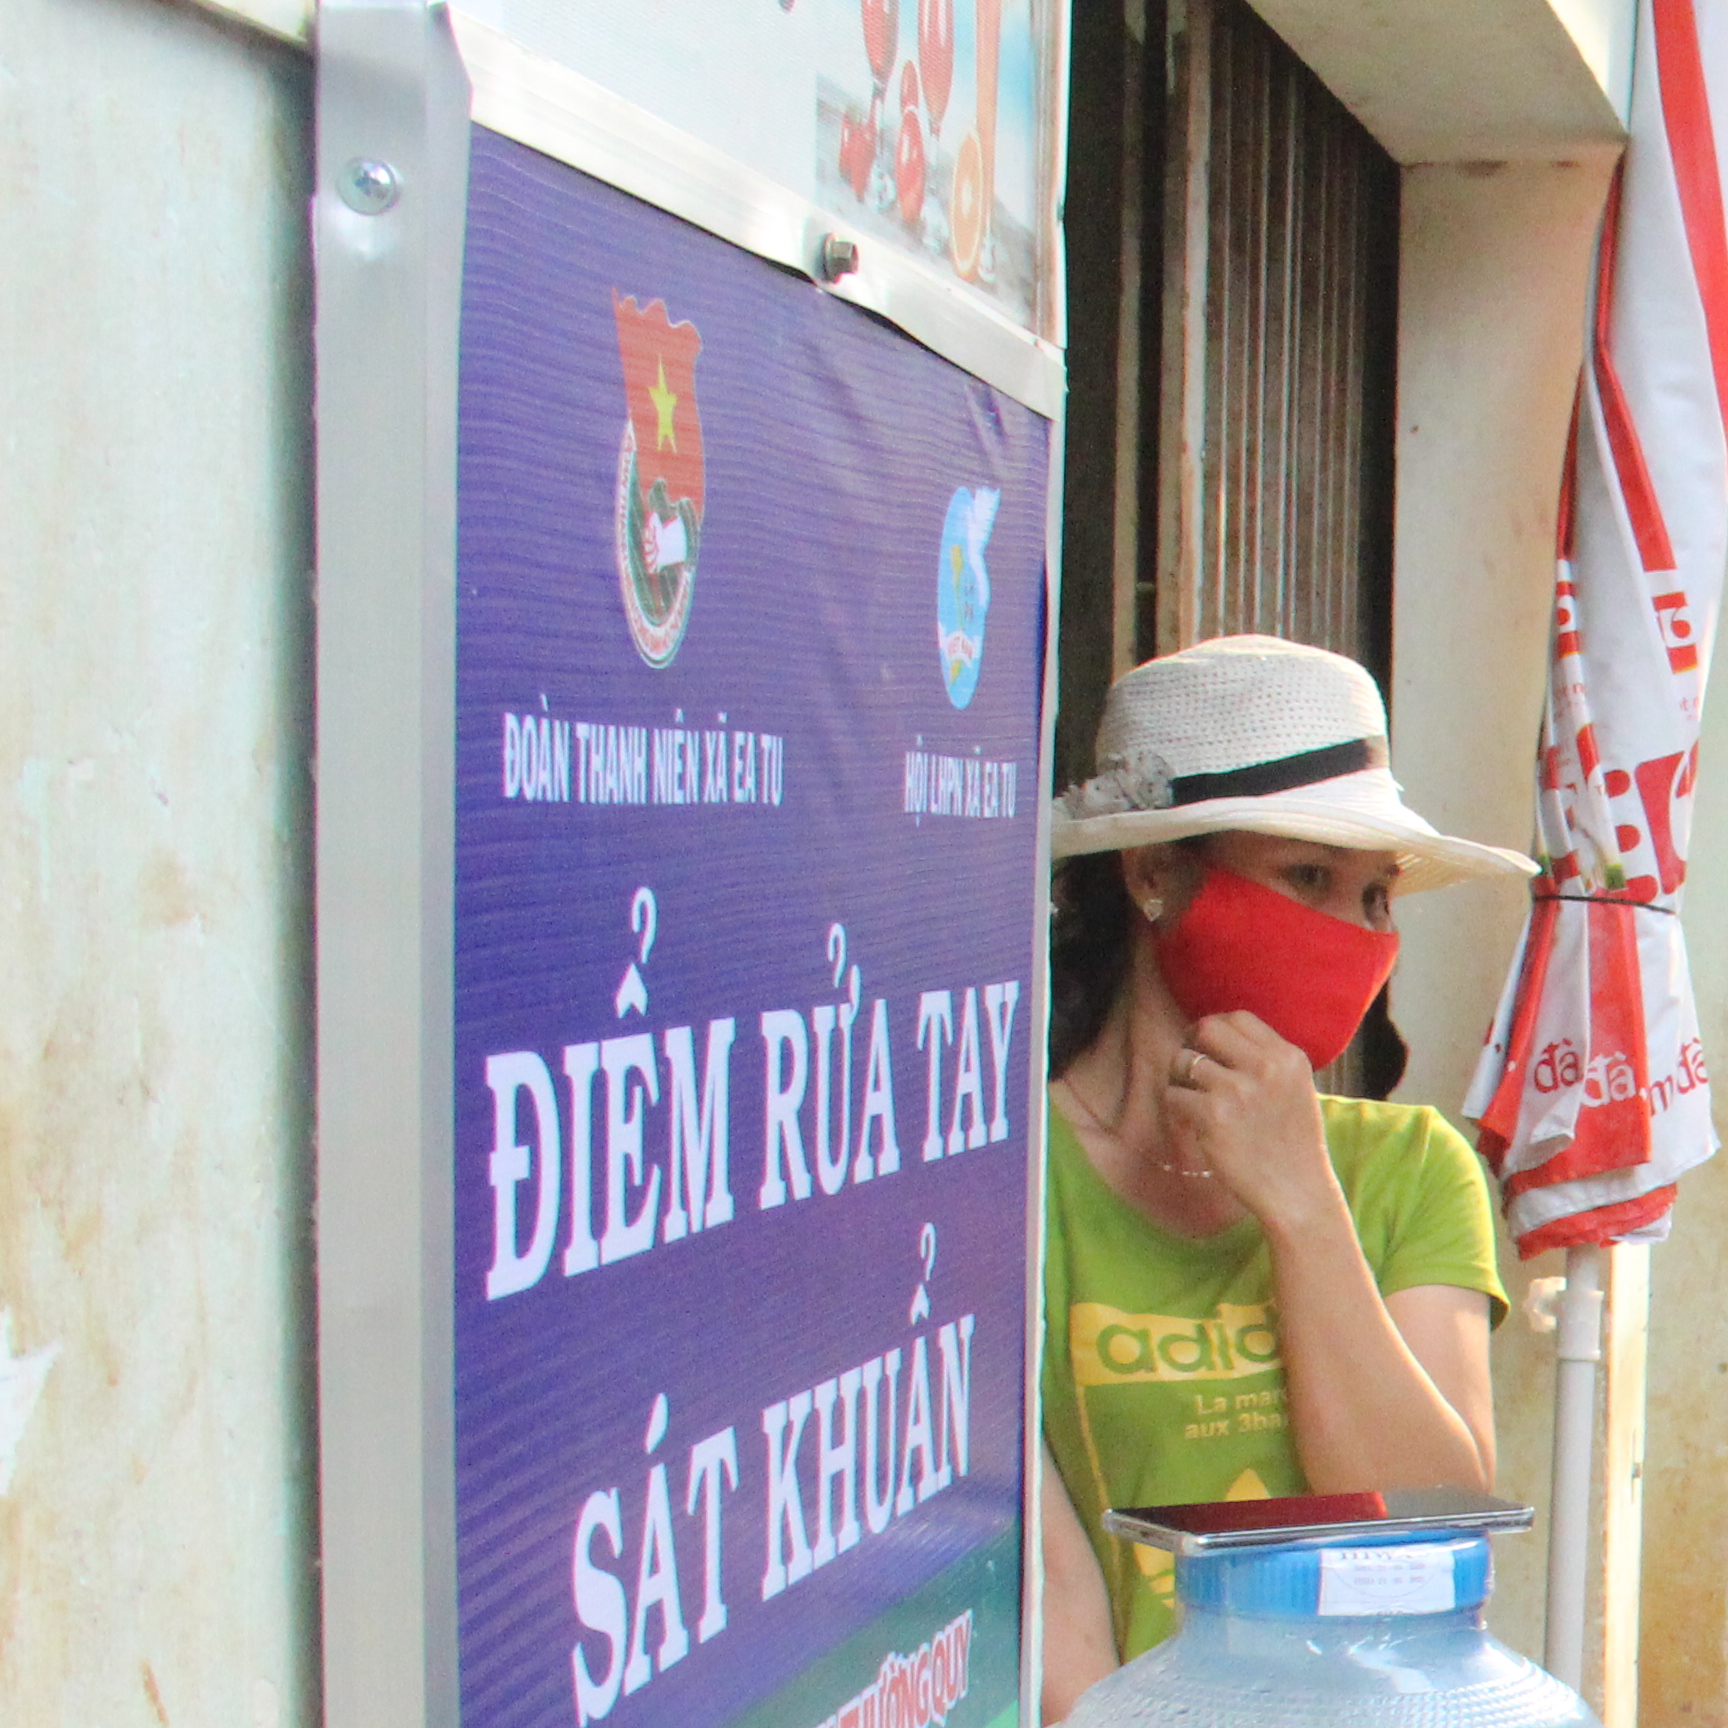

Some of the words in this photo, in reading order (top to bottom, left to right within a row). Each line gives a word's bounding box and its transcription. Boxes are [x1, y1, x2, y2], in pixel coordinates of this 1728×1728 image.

[504, 692, 571, 803] ĐOÀN
[575, 721, 649, 805] THANH
[652, 707, 700, 805] NIÊN
[703, 710, 728, 804] XÃ
[732, 730, 758, 804] EA
[759, 733, 784, 807] TU
[484, 886, 737, 1301] ĐIỂM
[759, 921, 902, 1211] RỬA
[916, 979, 1020, 1164] TAY
[1184, 1418, 1230, 1440] aux
[1195, 1393, 1228, 1415] La
[571, 1391, 741, 1728] SÁT
[760, 1222, 976, 1602] KHUẨN
[928, 1608, 973, 1728] QUY
